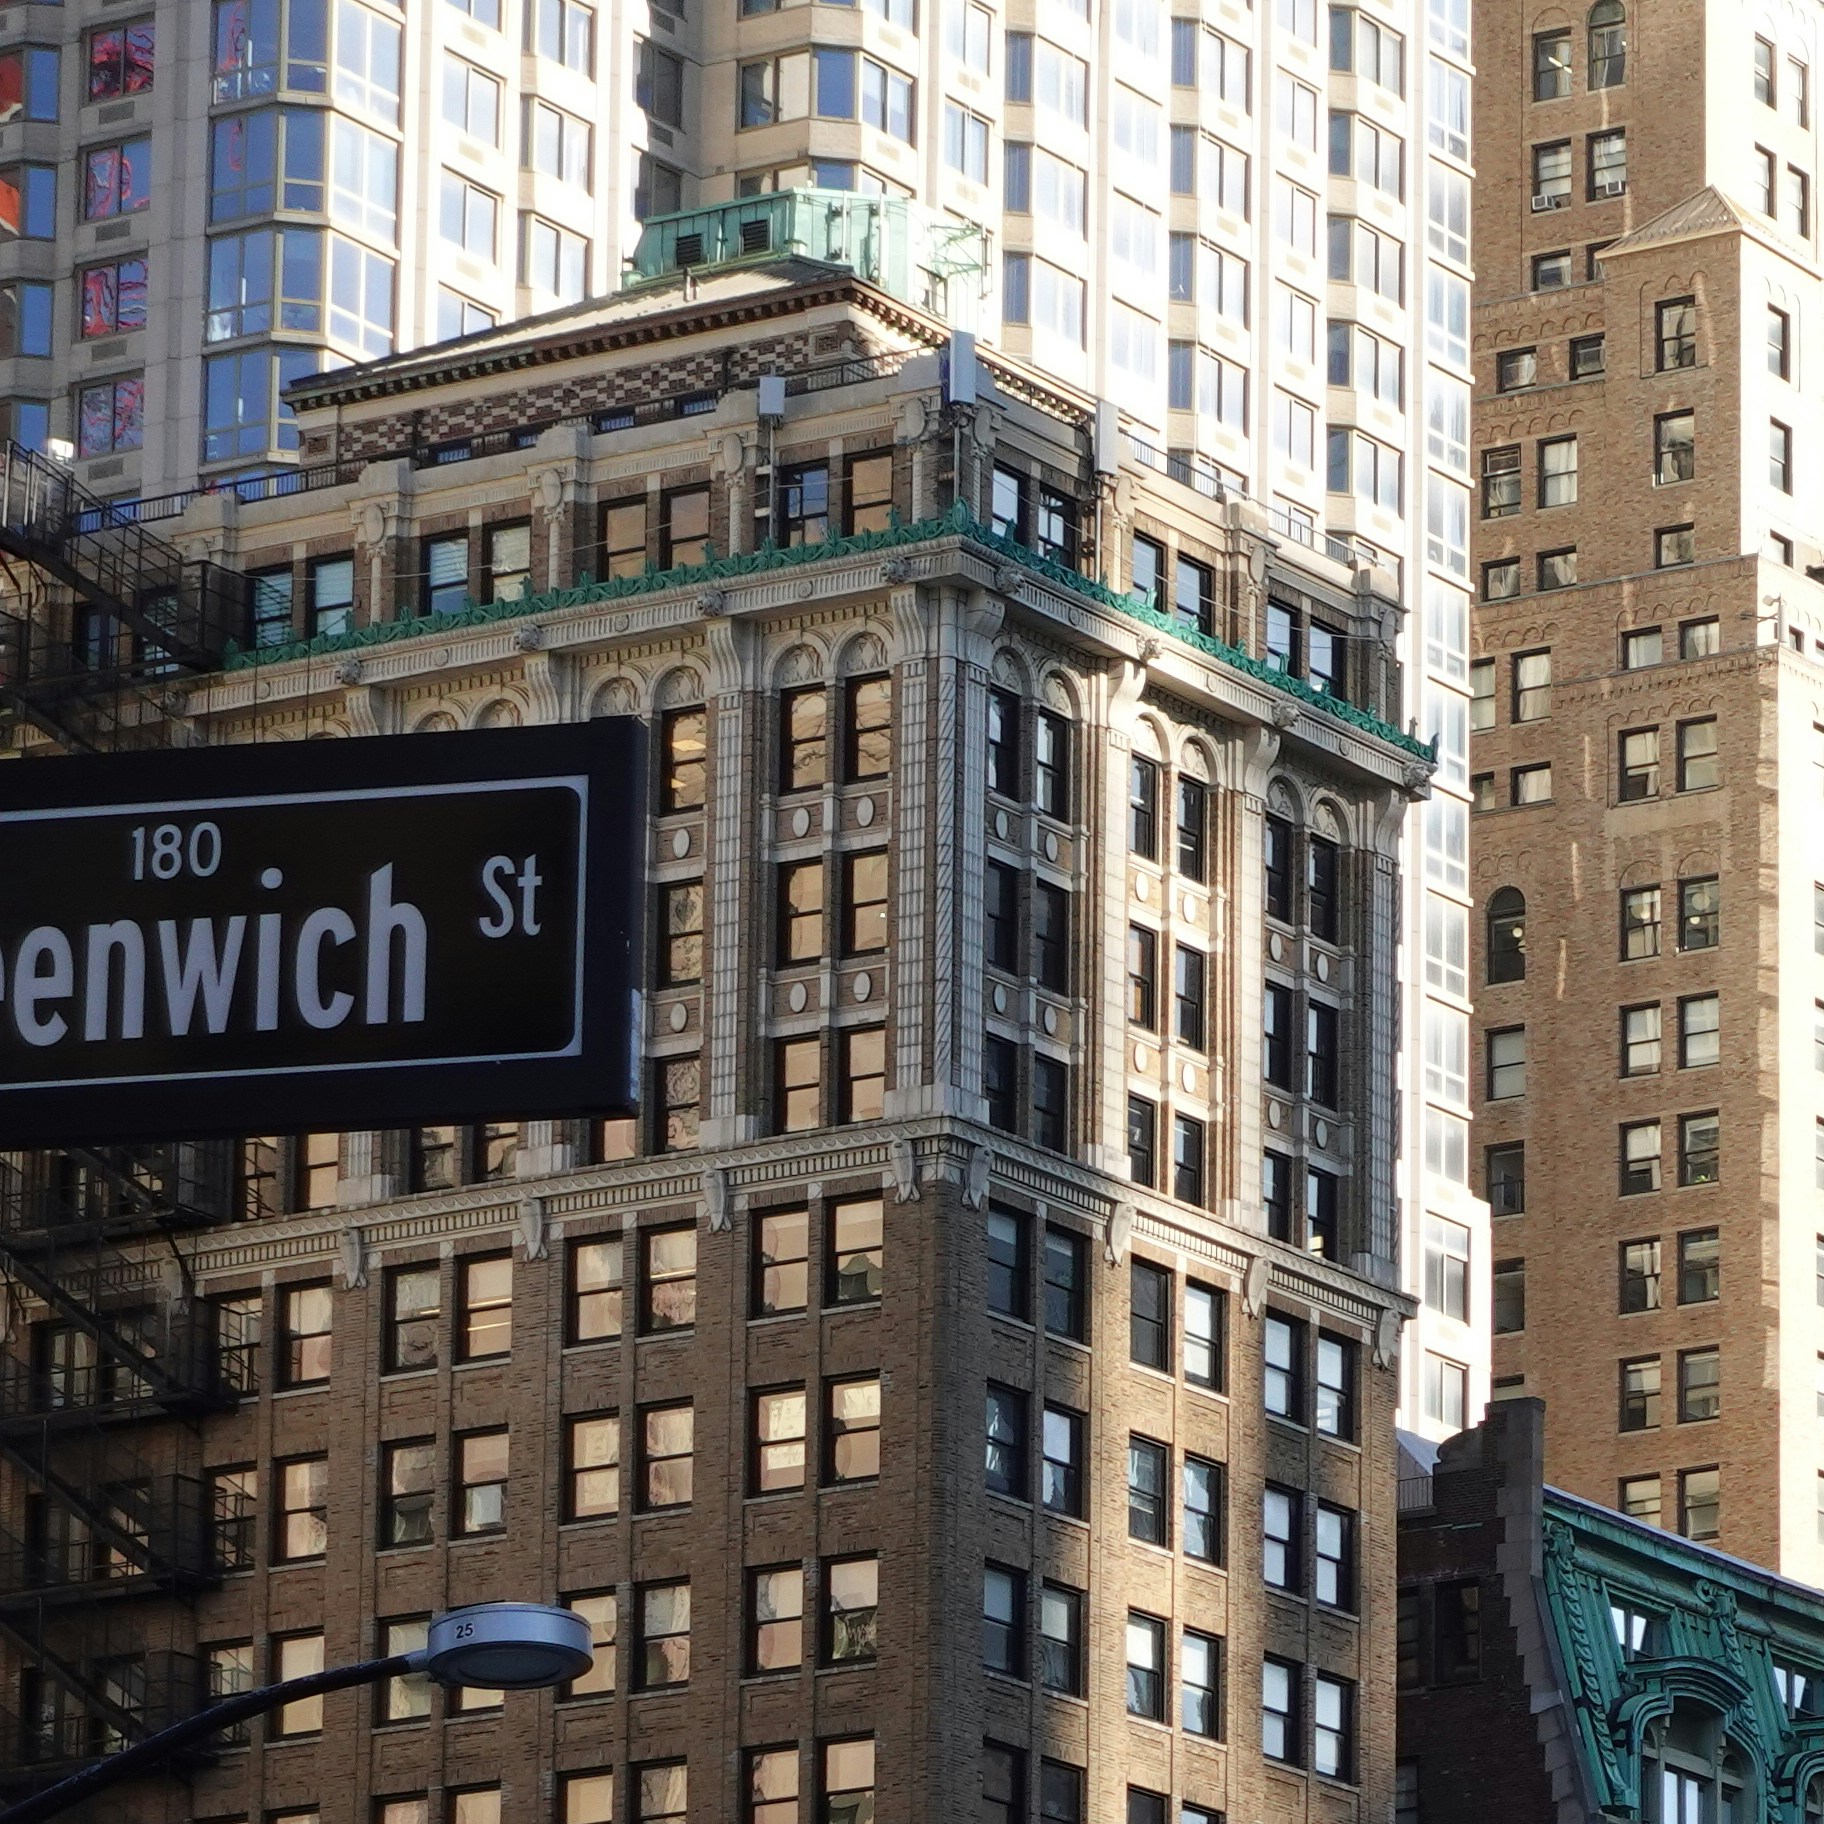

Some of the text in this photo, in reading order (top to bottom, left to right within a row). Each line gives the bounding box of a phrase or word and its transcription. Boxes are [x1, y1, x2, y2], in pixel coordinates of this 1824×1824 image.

[130, 821, 222, 881] 180
[0, 853, 545, 1047] enwich St
[456, 1622, 474, 1639] 25
